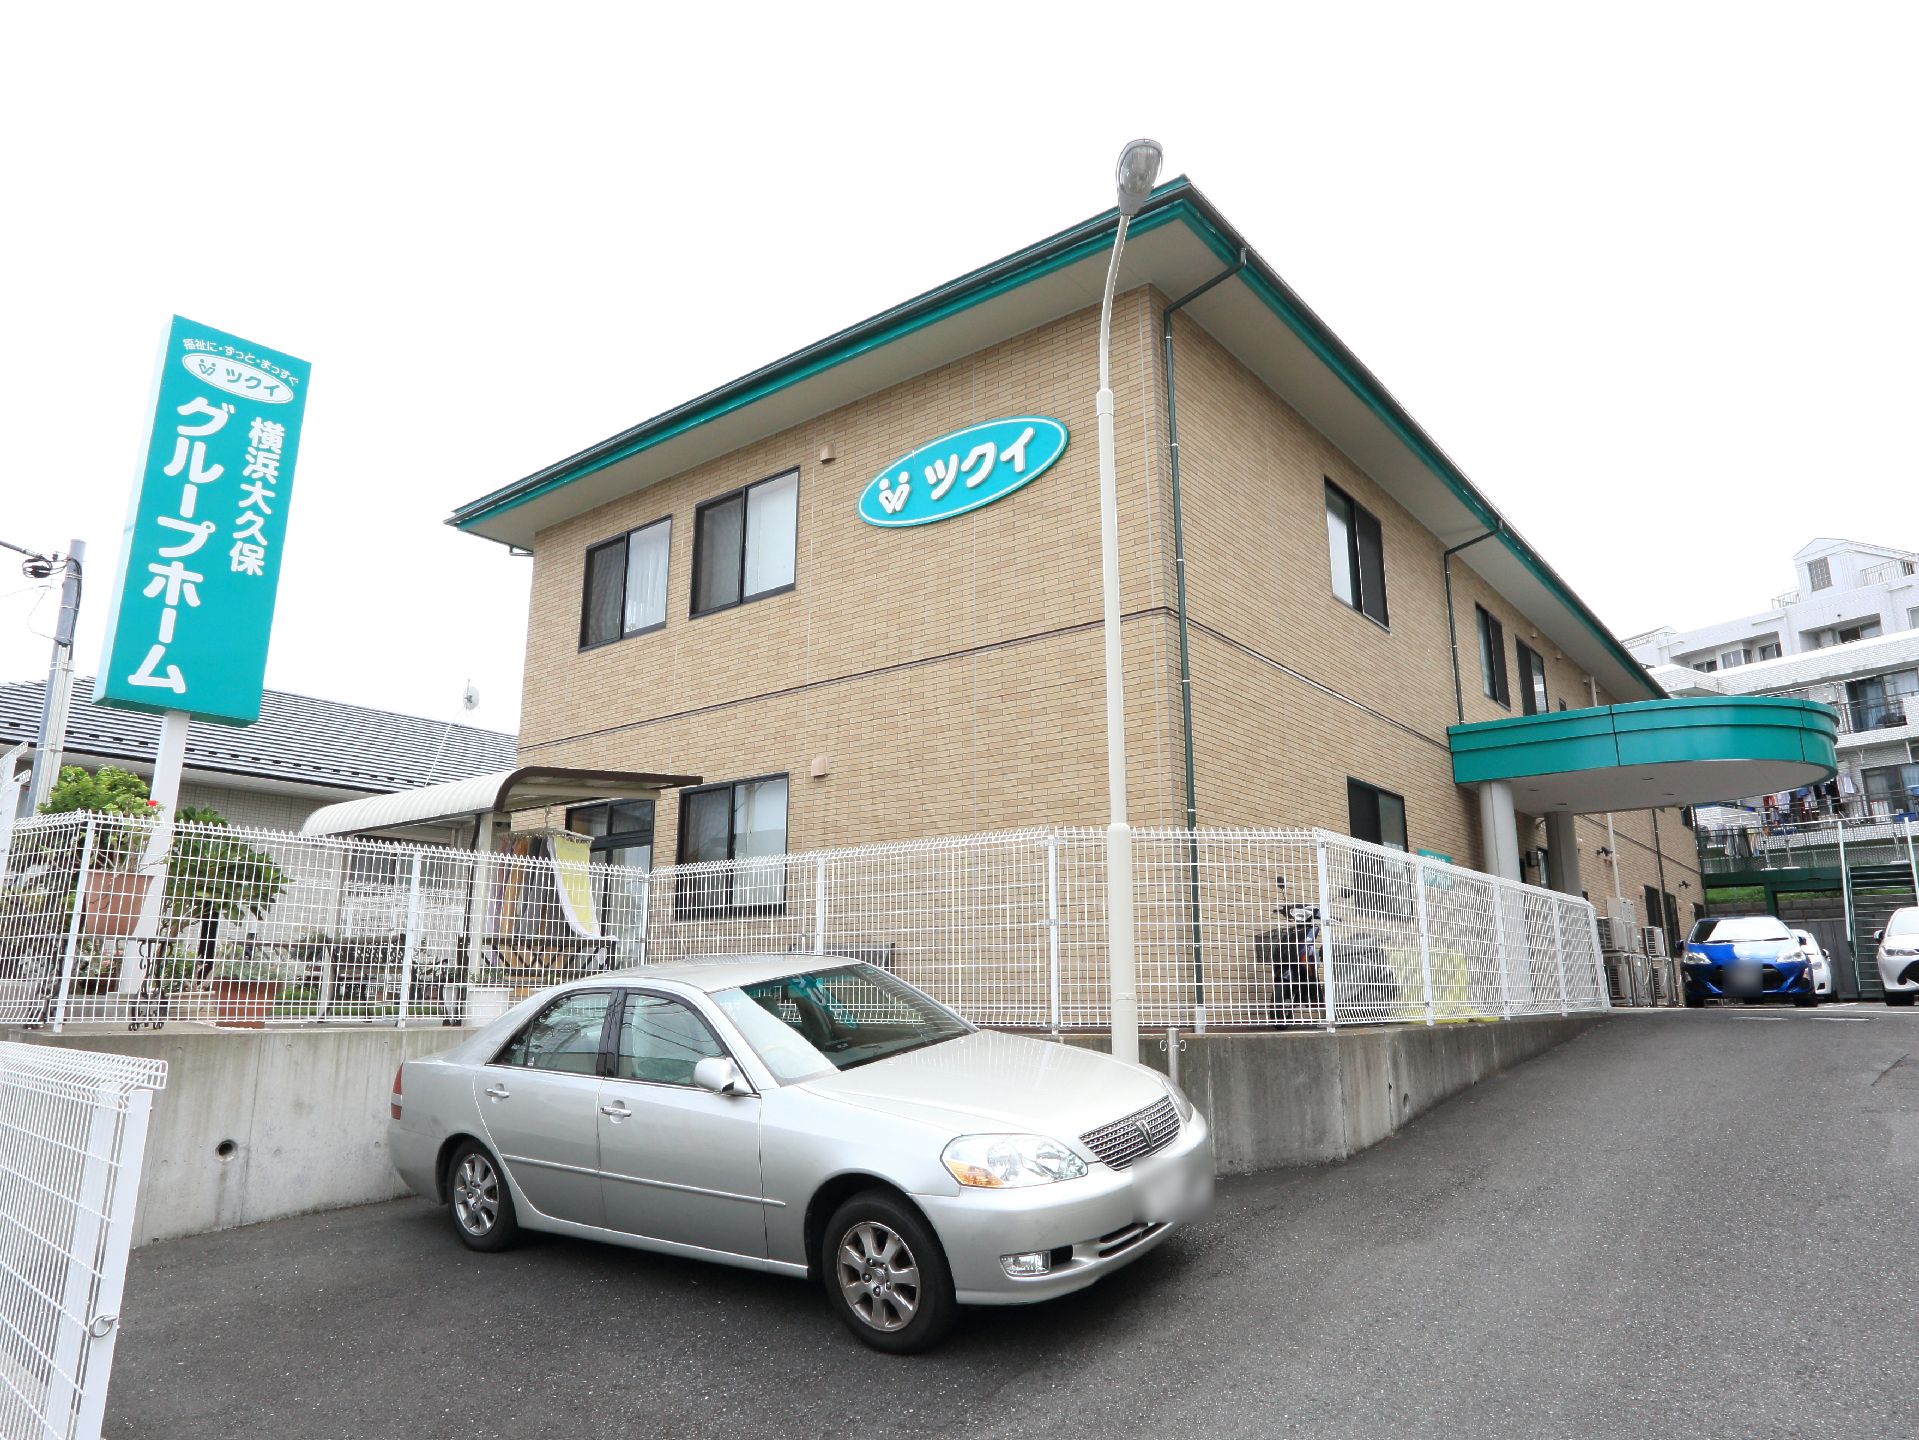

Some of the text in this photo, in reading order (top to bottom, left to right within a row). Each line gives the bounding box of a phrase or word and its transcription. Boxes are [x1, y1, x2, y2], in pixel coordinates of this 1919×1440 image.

[226, 368, 280, 397] ツクイ
[230, 417, 285, 576] 横浜大久保
[924, 427, 1036, 501] ツクイ
[128, 397, 236, 693] グループホーム
